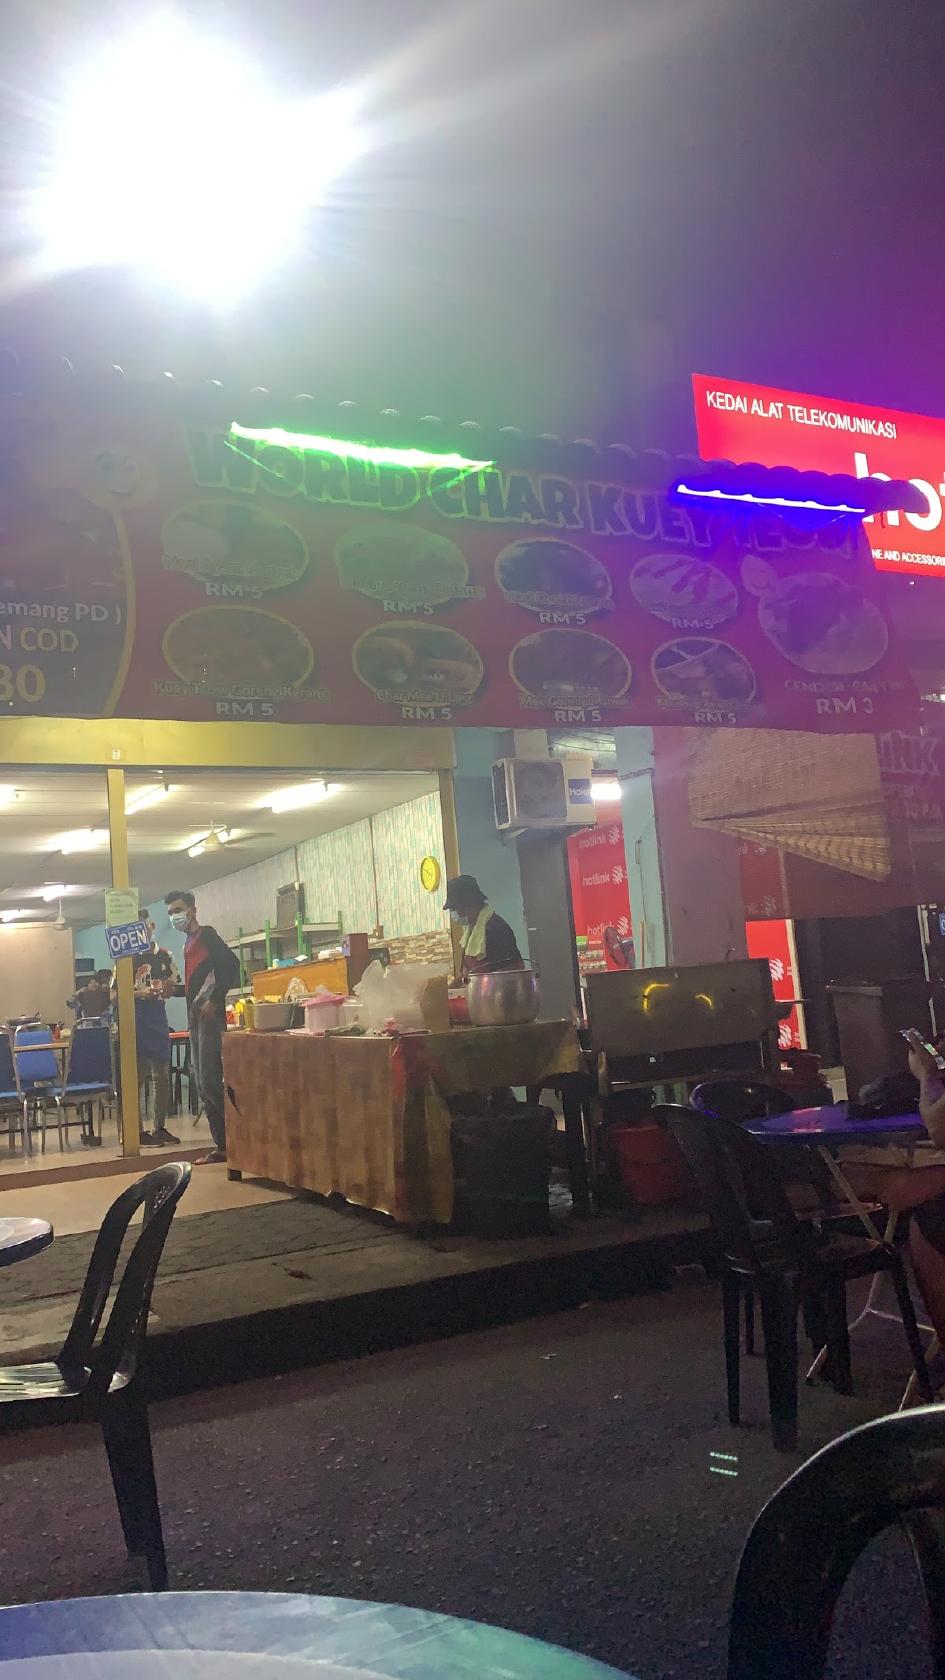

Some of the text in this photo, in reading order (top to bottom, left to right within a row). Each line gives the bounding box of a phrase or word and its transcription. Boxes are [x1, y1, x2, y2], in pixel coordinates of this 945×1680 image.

[706, 390, 897, 439] KEDAI ALAT TELEKOMUNIKASI
[186, 424, 421, 511] WORLD
[427, 463, 584, 529] CHAR
[884, 550, 901, 562] AND
[75, 603, 109, 623] PD
[539, 612, 587, 625] RM 5
[671, 617, 714, 630] RM 5
[19, 626, 80, 653] COD
[215, 702, 274, 716] RM 5
[815, 696, 875, 715] RM 3
[401, 706, 453, 721] RM 5
[554, 709, 603, 723] RM 5
[694, 711, 737, 724] RM 5
[582, 871, 610, 887] hotlink
[110, 929, 147, 952] OPEN
